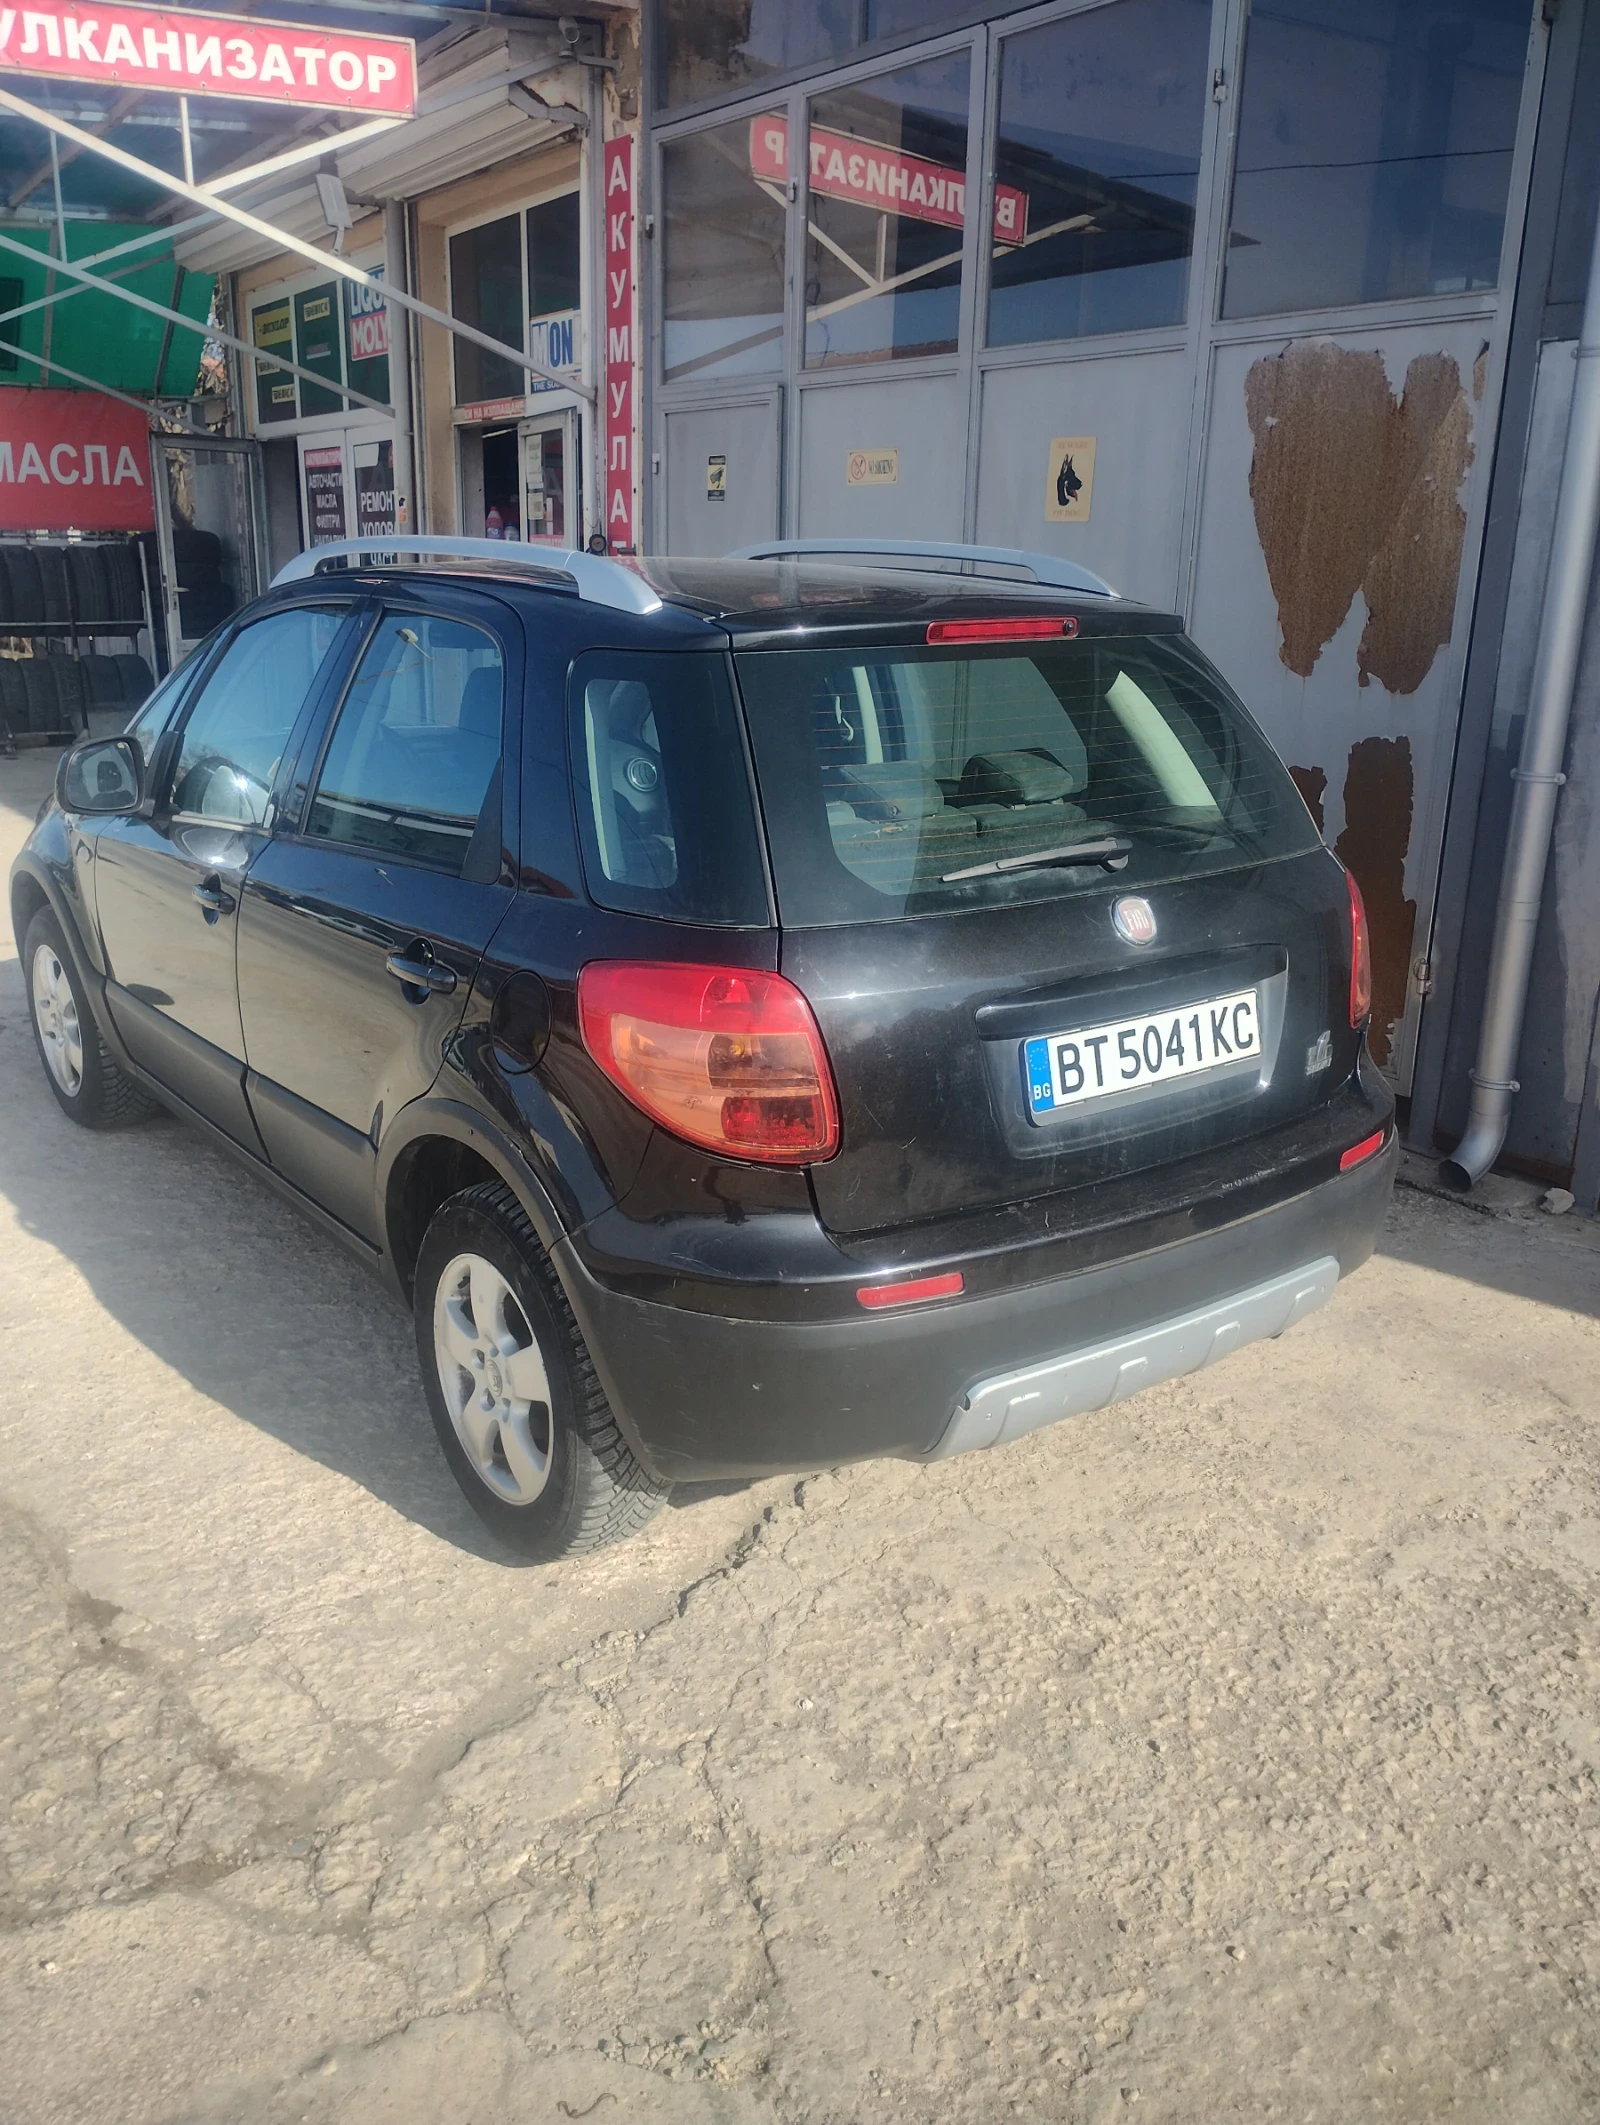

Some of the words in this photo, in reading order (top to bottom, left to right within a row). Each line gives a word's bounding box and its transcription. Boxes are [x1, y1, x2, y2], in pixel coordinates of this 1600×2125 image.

[1056, 1035, 1108, 1095] BT
[1117, 1014, 1203, 1080] 5041
[1210, 1002, 1254, 1057] KC
[1033, 1083, 1051, 1100] BG
